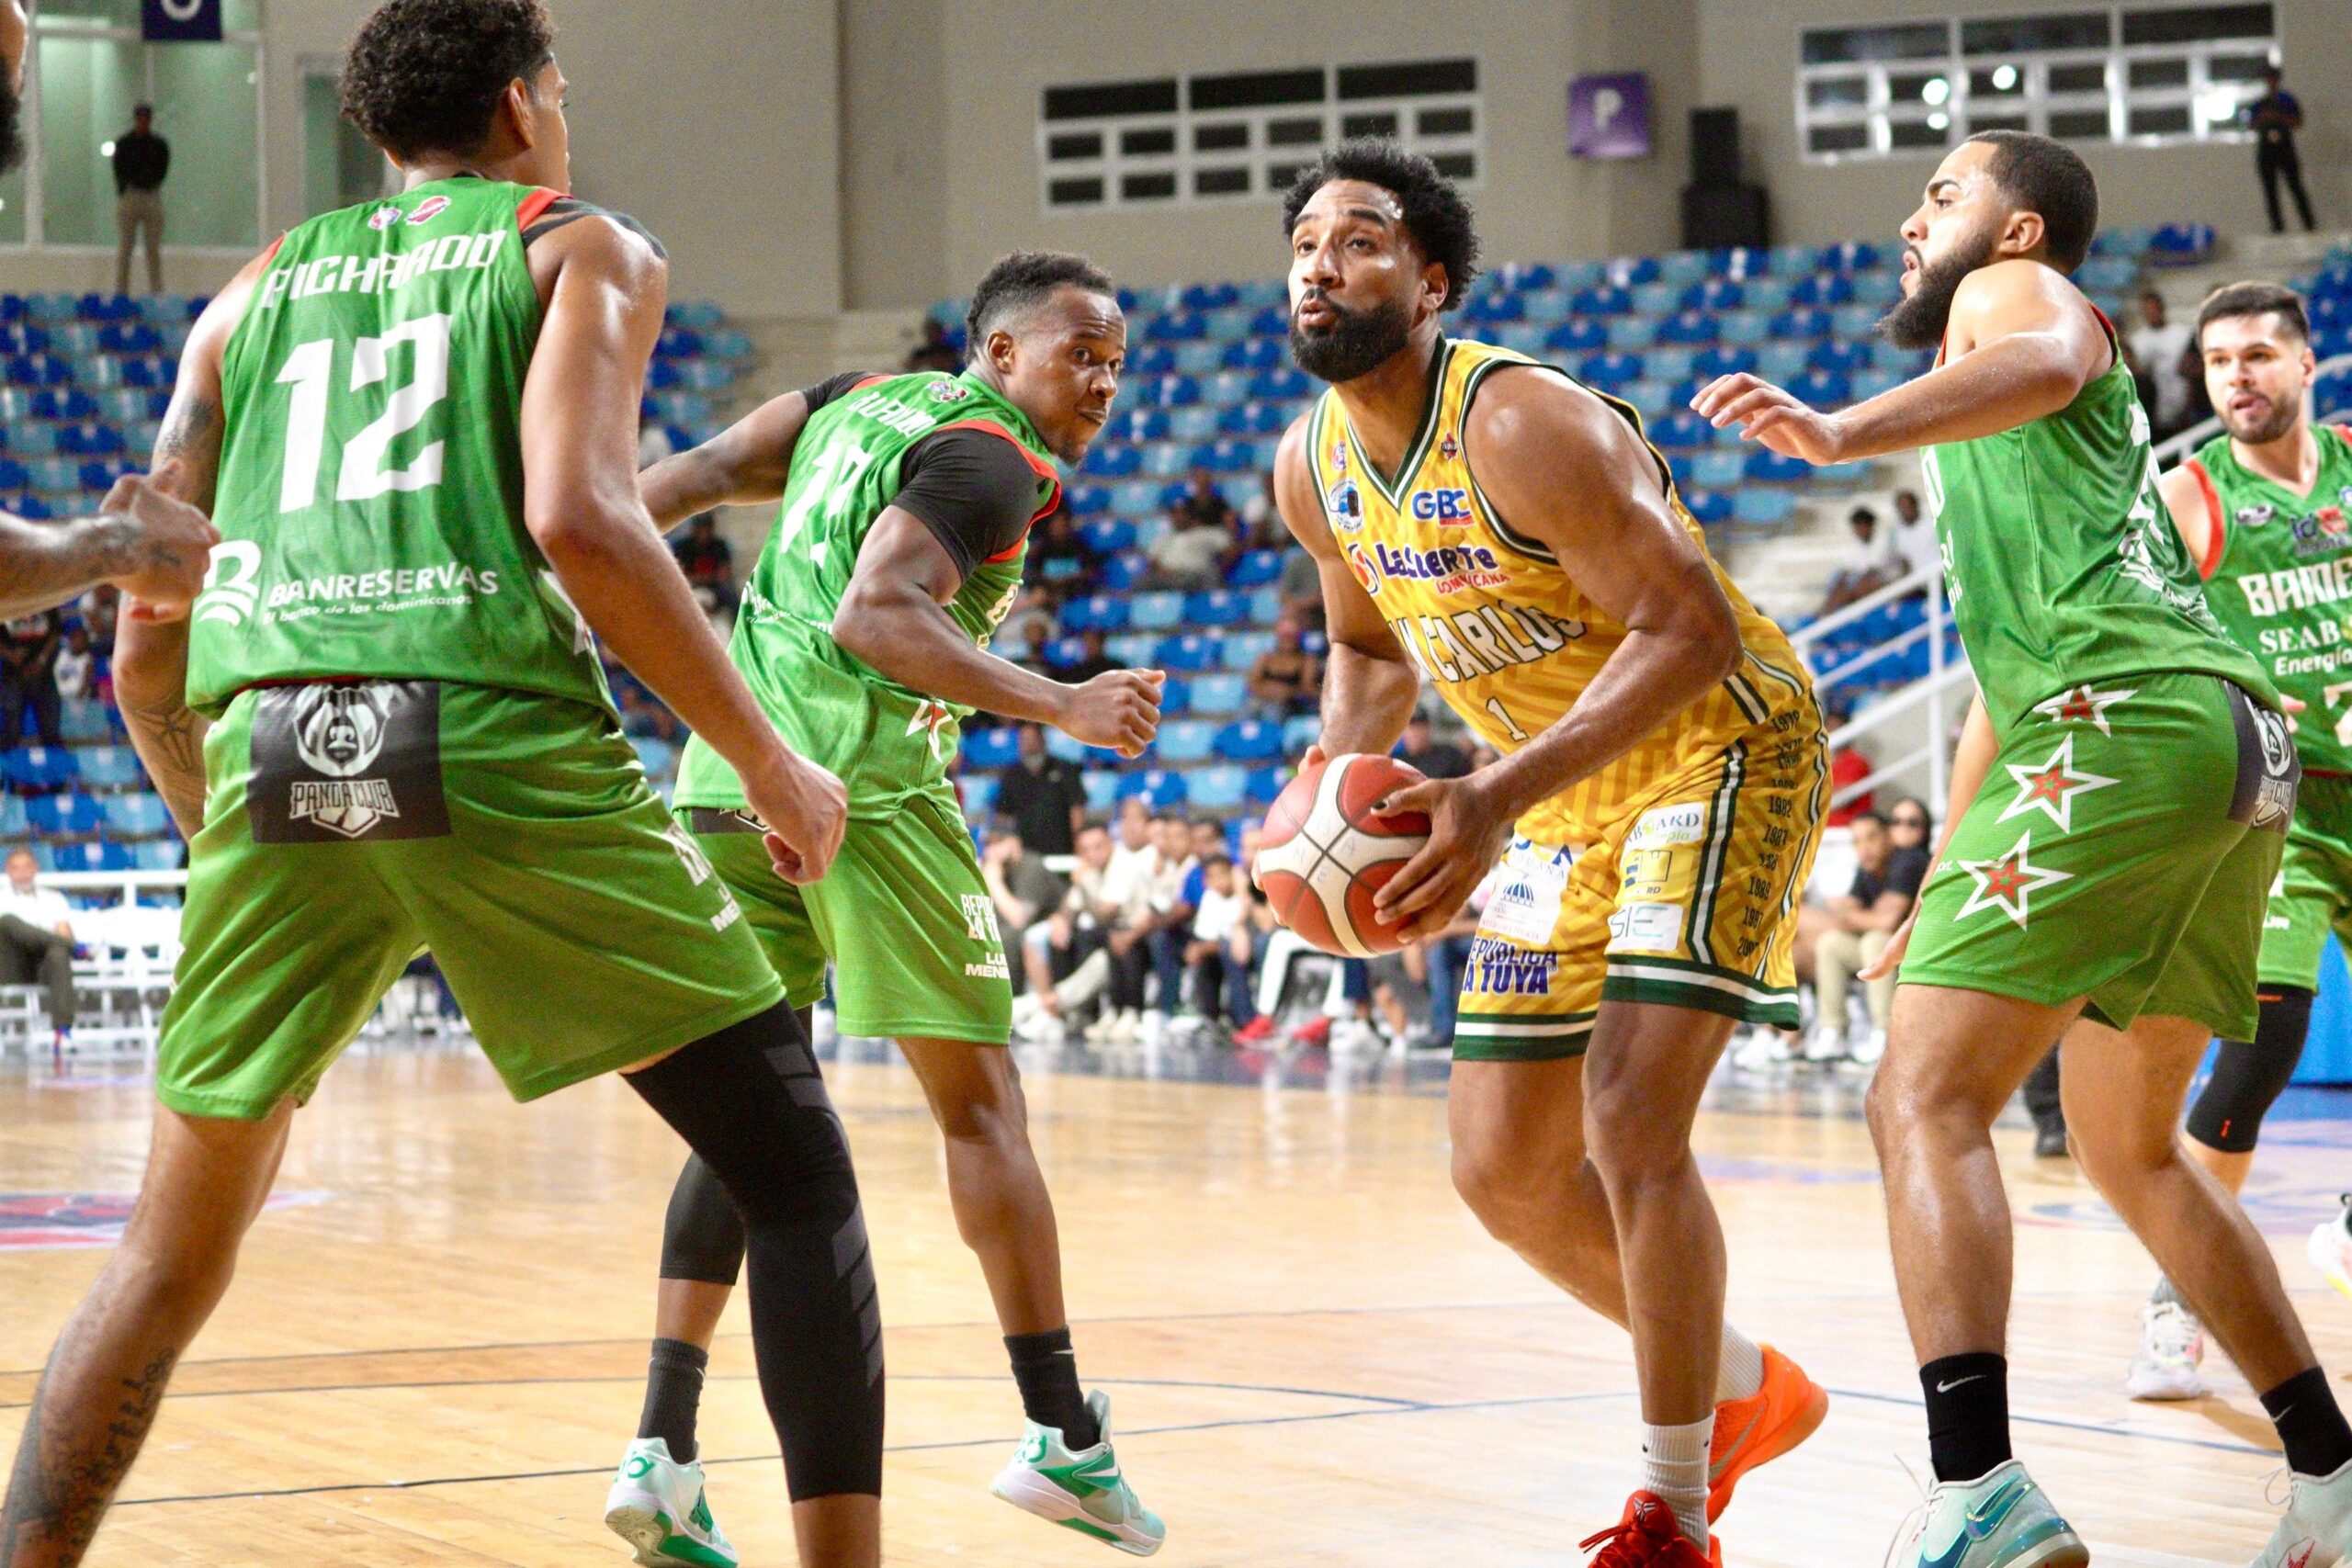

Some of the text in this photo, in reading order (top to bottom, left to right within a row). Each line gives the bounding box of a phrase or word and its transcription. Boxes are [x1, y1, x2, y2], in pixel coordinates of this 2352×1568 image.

[262, 230, 507, 309] PICHARDO
[275, 313, 452, 513] 12
[1412, 490, 1472, 519] GBC
[267, 561, 499, 607] BANRESERVAS
[324, 604, 345, 615] de
[349, 602, 371, 615] los
[1486, 696, 1530, 742] 1
[291, 782, 355, 816] PANDA
